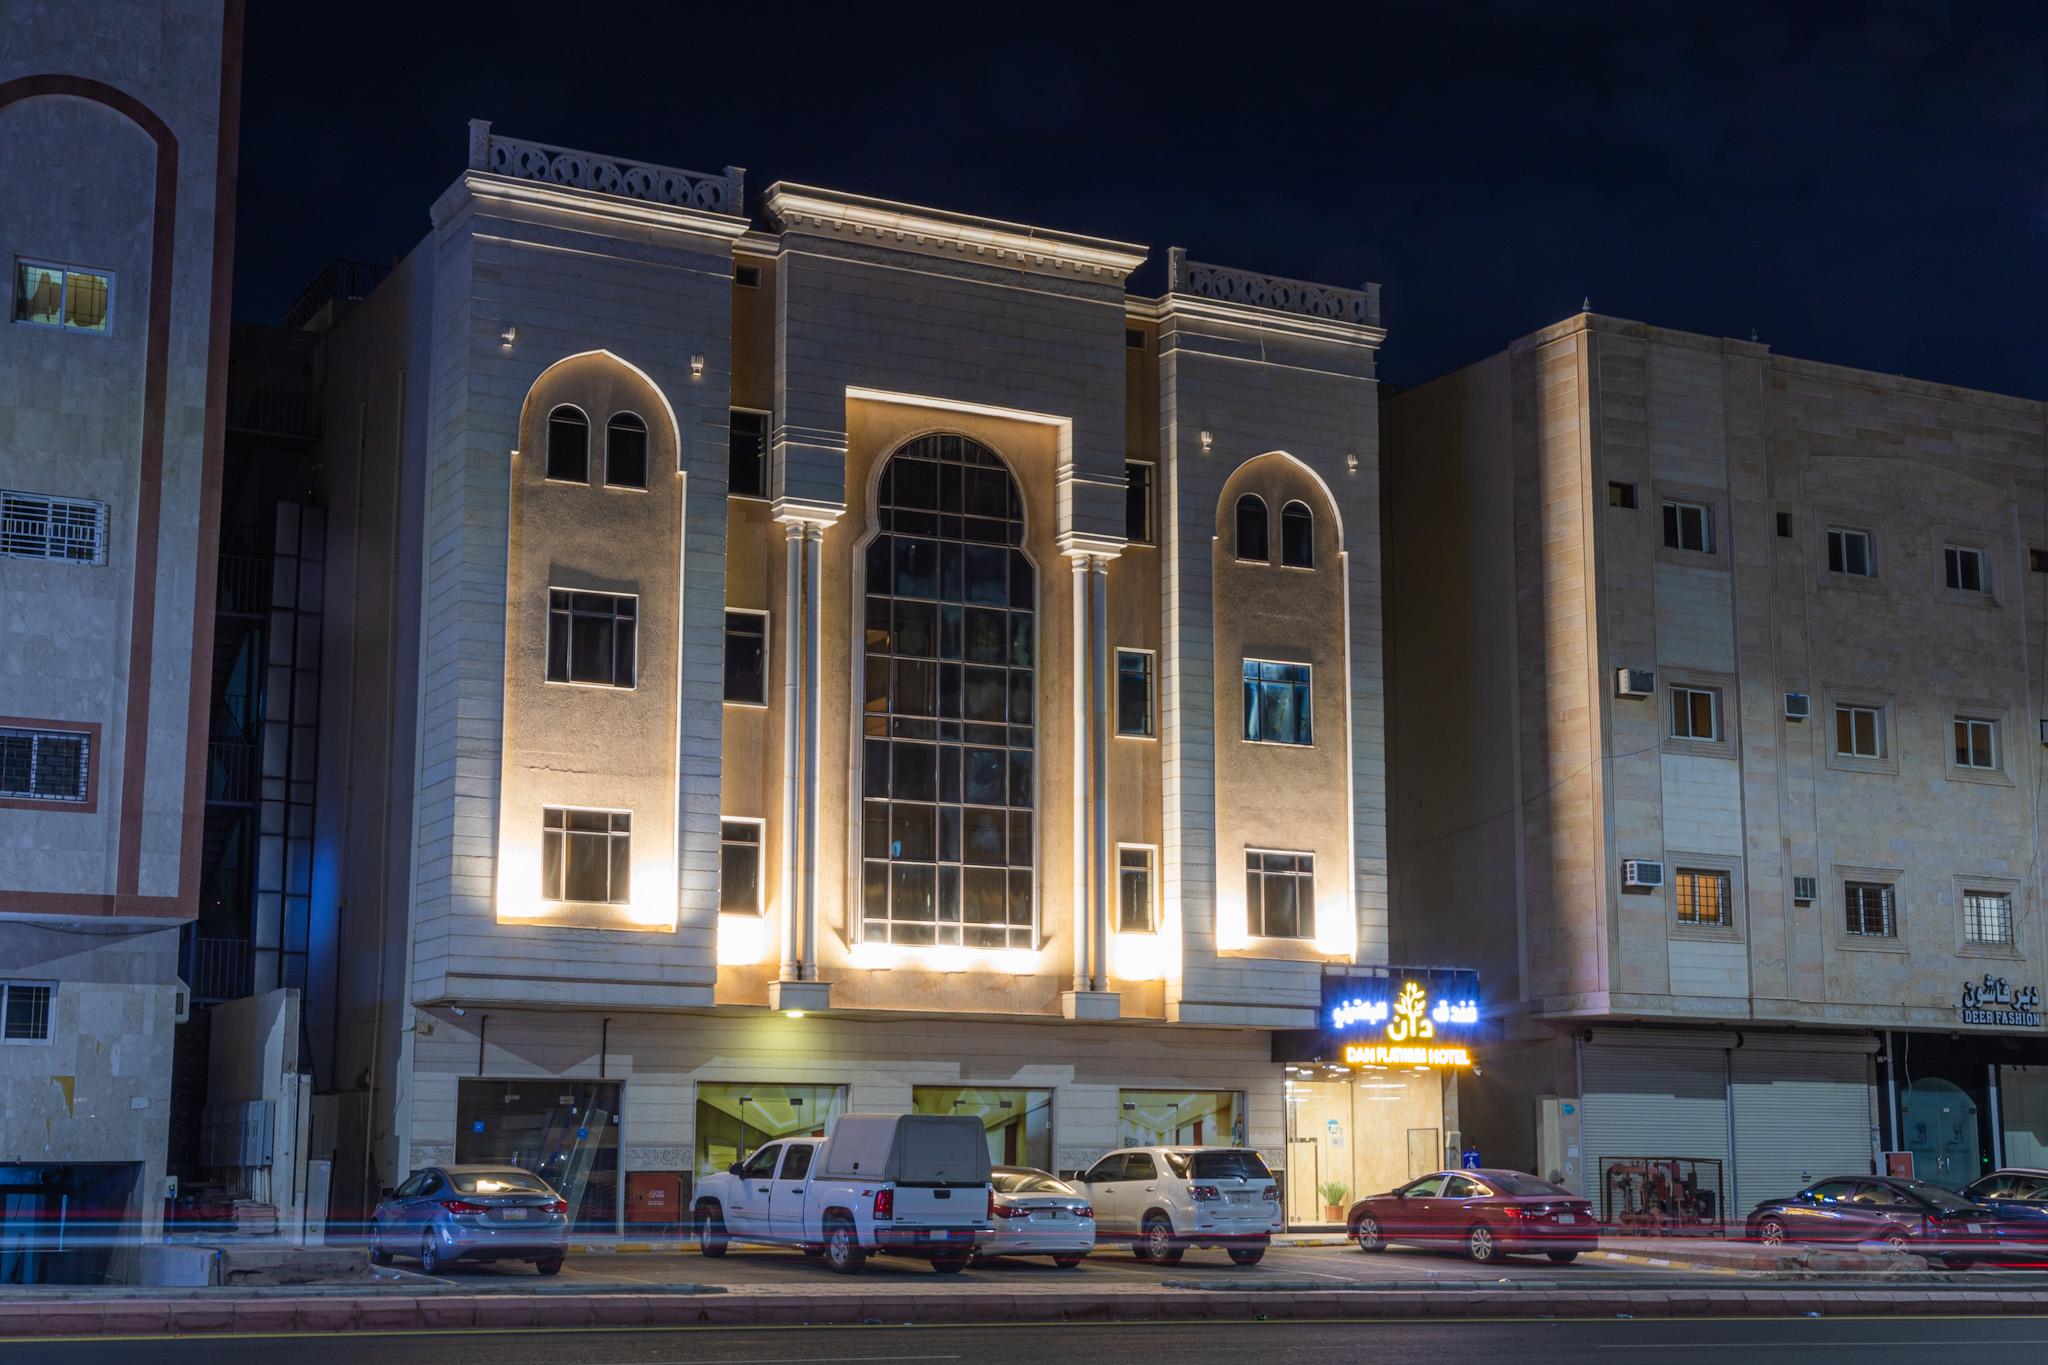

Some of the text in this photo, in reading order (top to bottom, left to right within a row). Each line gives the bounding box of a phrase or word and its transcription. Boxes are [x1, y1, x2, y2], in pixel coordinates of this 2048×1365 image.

[1963, 973, 2039, 1011] دير فاشون
[1432, 999, 1478, 1023] فندق
[1964, 1010, 2040, 1026] DEER FASHION
[1346, 1046, 1375, 1063] DAN
[1428, 1048, 1471, 1065] HOTEL
